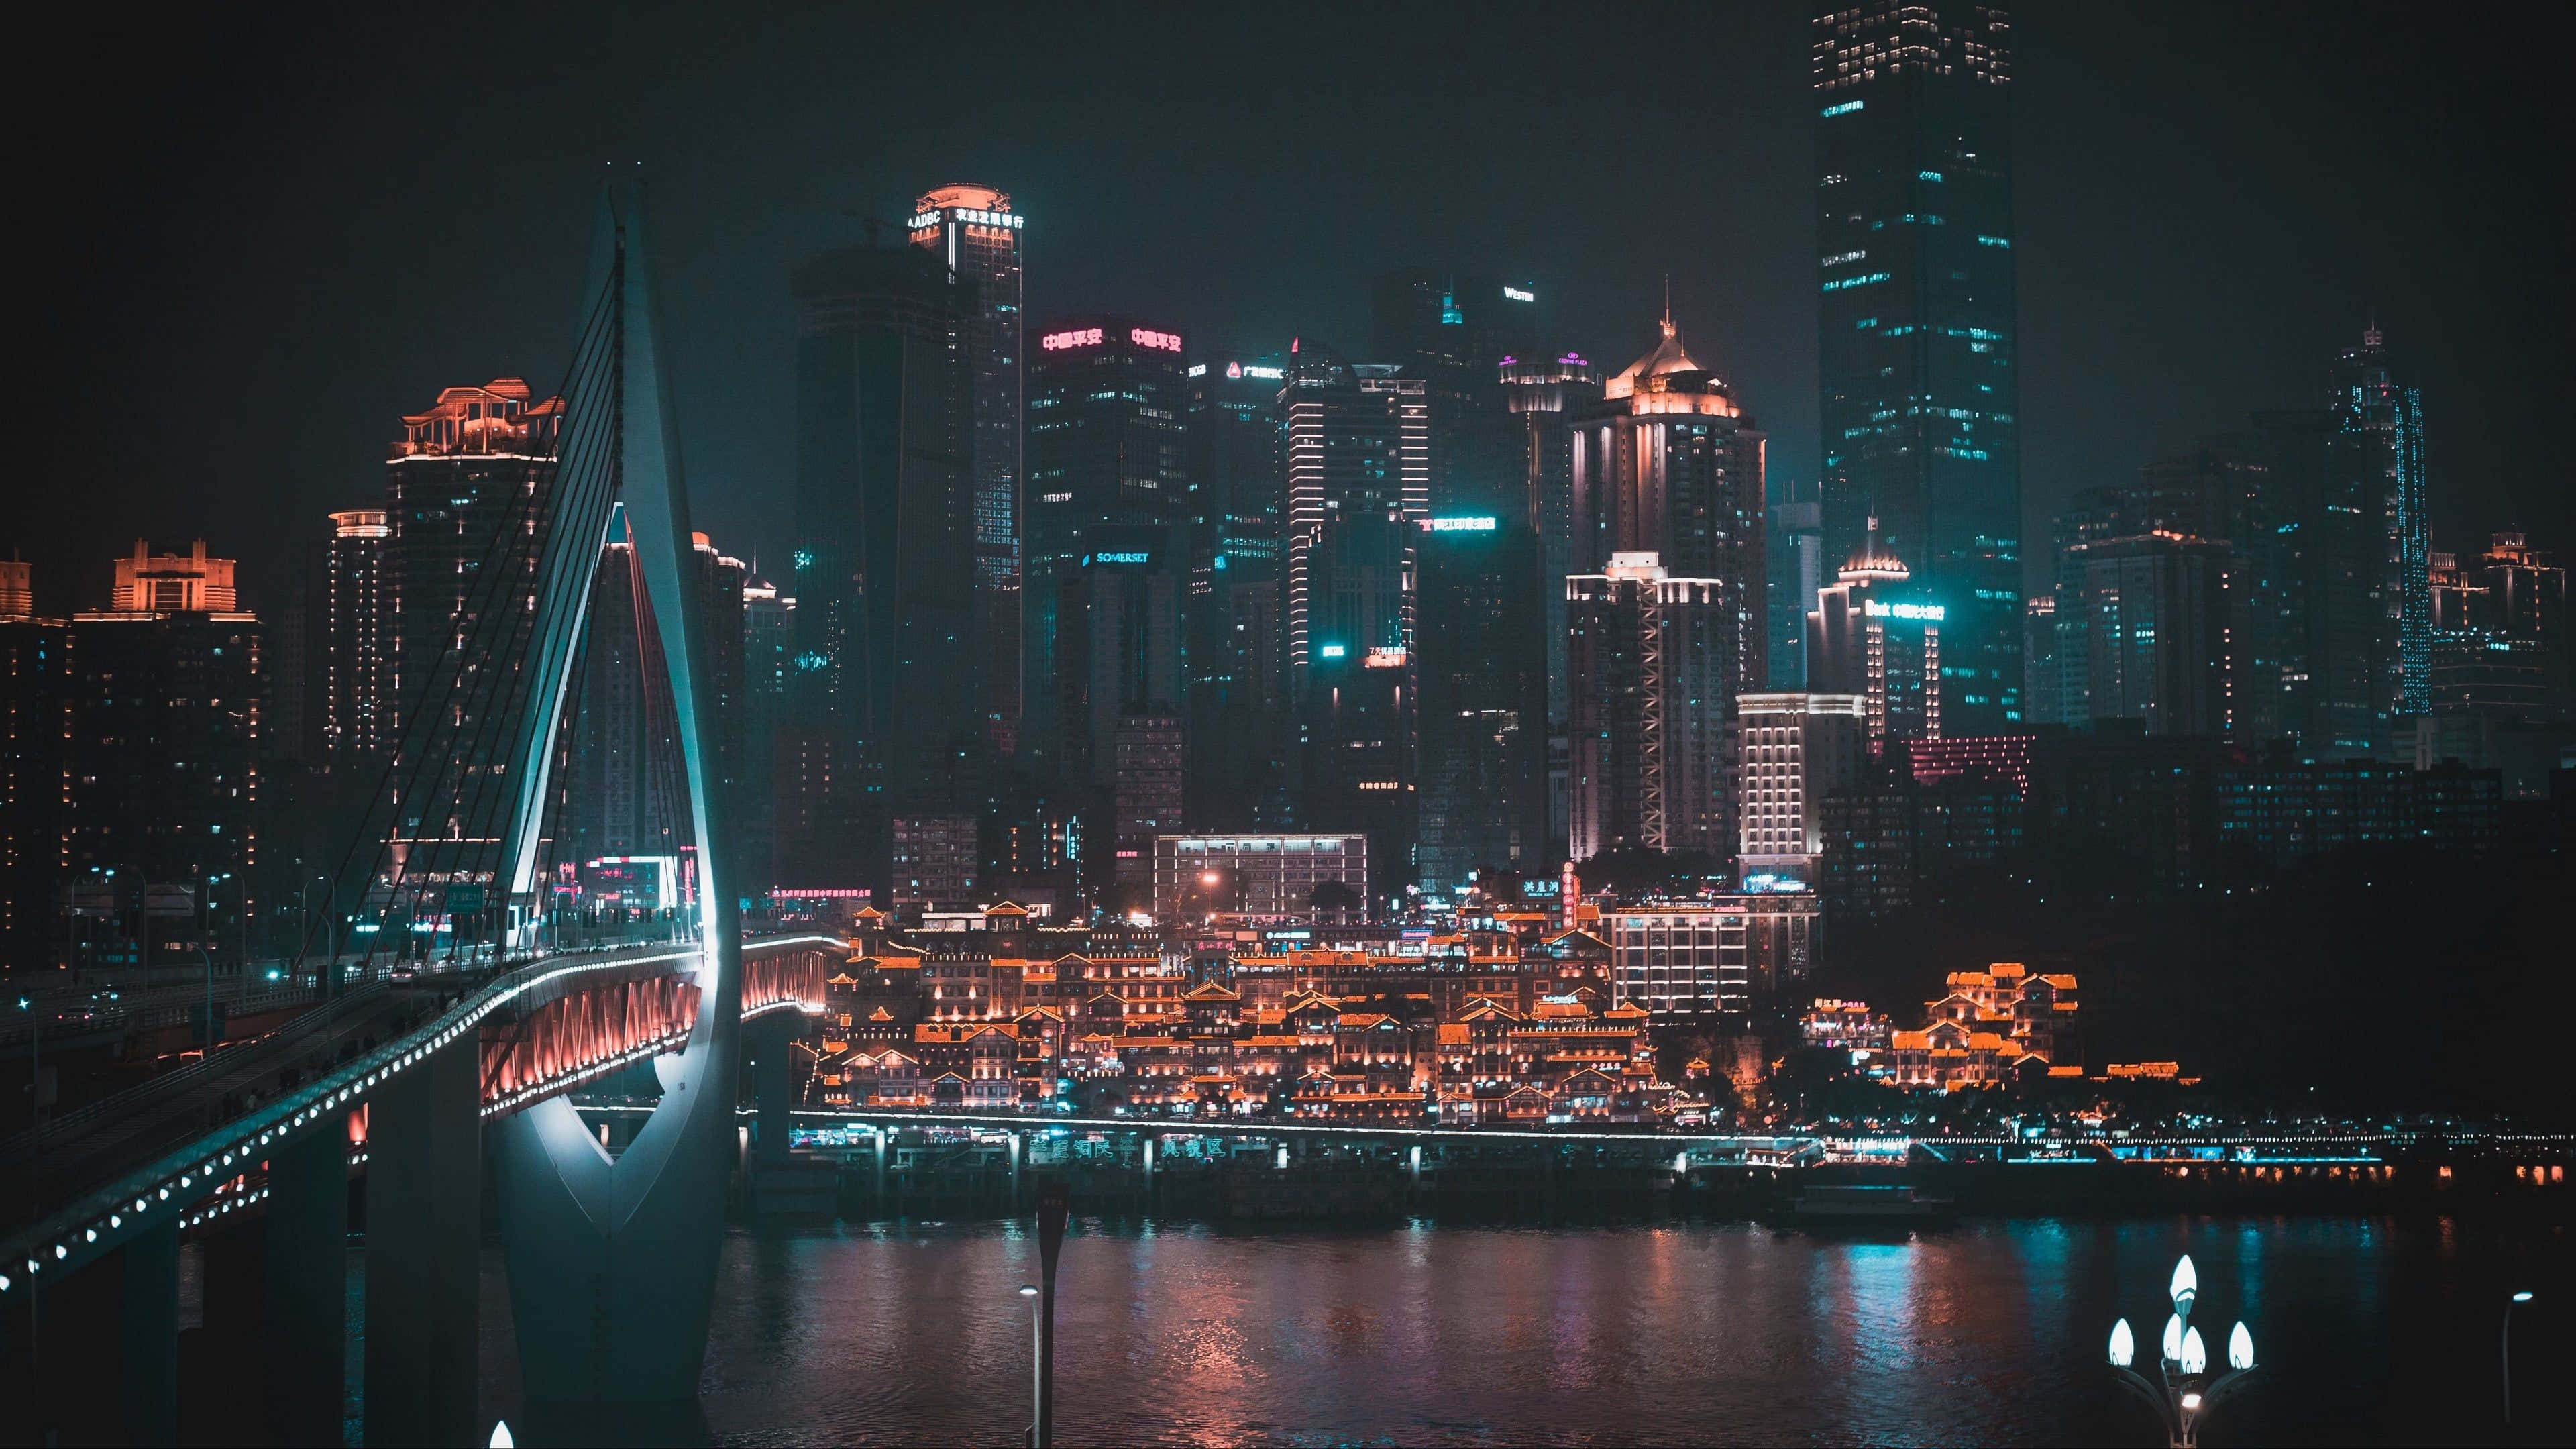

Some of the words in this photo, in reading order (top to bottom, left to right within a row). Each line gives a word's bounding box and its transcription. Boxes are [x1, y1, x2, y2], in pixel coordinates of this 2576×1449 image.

[914, 210, 941, 228] ADBC
[1043, 328, 1102, 351] 中国平安
[1132, 328, 1181, 352] 中国平安
[1097, 553, 1149, 563] SOMERSET
[1523, 880, 1559, 892] 洪崖洞
